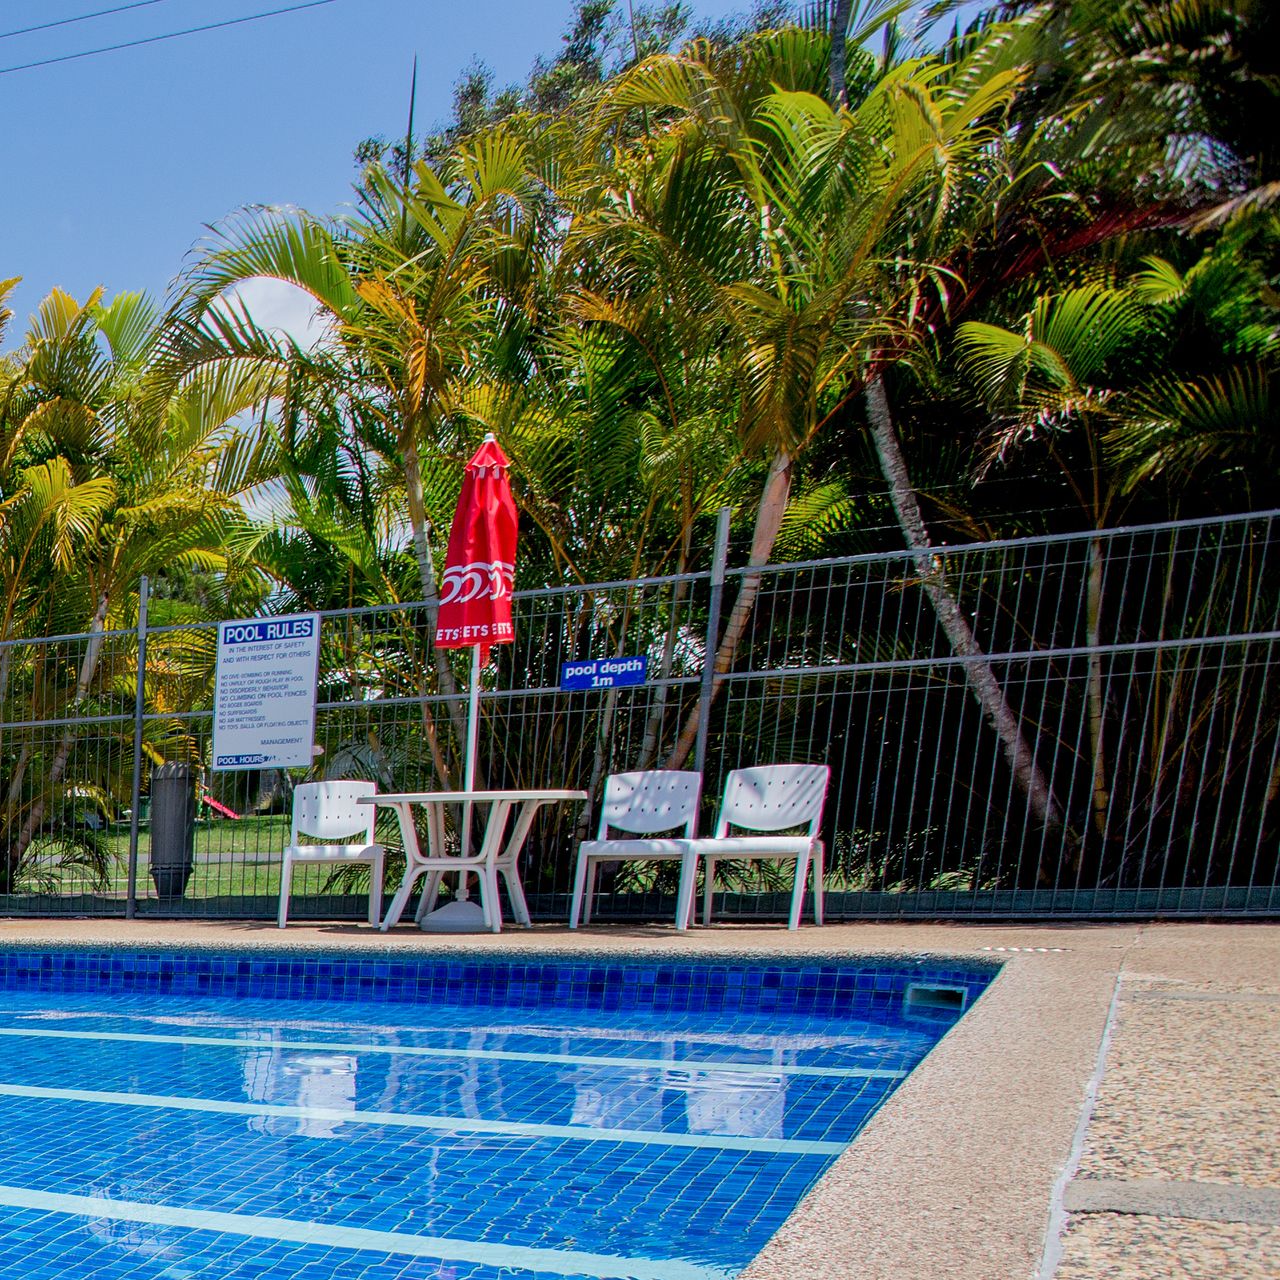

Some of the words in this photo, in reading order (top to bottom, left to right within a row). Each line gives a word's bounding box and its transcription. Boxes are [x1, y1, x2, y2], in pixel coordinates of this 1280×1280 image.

[226, 626, 263, 642] POOL
[267, 621, 311, 638] RULES
[566, 663, 597, 679] pool
[600, 659, 642, 675] depth
[591, 676, 613, 687] 1m
[218, 757, 238, 765] POOL
[239, 756, 265, 764] HOURS
